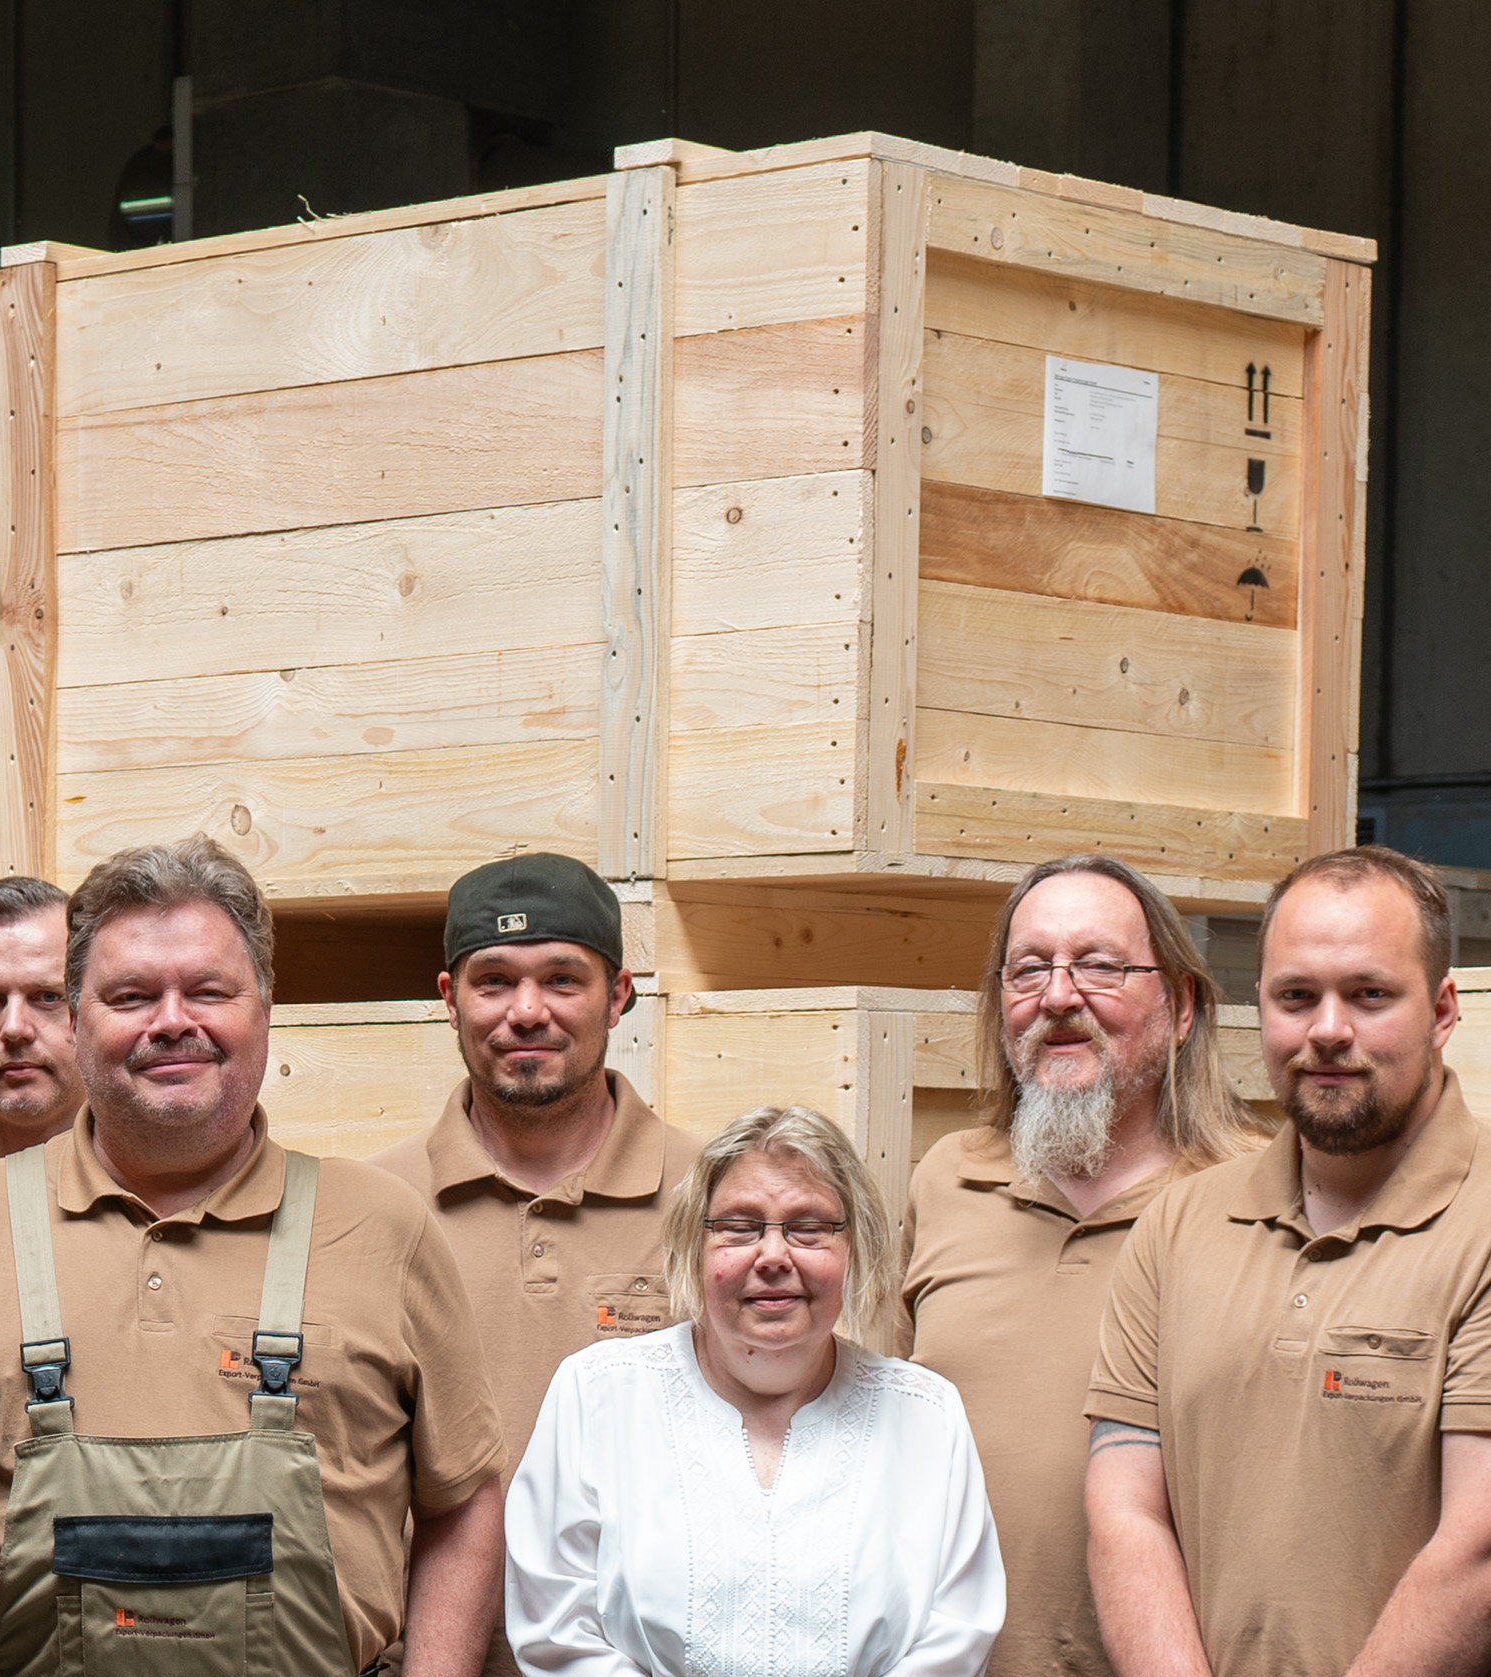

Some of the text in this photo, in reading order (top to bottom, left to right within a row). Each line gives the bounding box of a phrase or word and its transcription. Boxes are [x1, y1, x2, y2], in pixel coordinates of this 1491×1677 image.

[618, 1312, 661, 1323] Rollwagen
[297, 1377, 321, 1388] GmbH
[1343, 1376, 1390, 1390] Rollwagen
[1396, 1395, 1422, 1403] GmbH
[138, 1614, 187, 1626] Rollwagen
